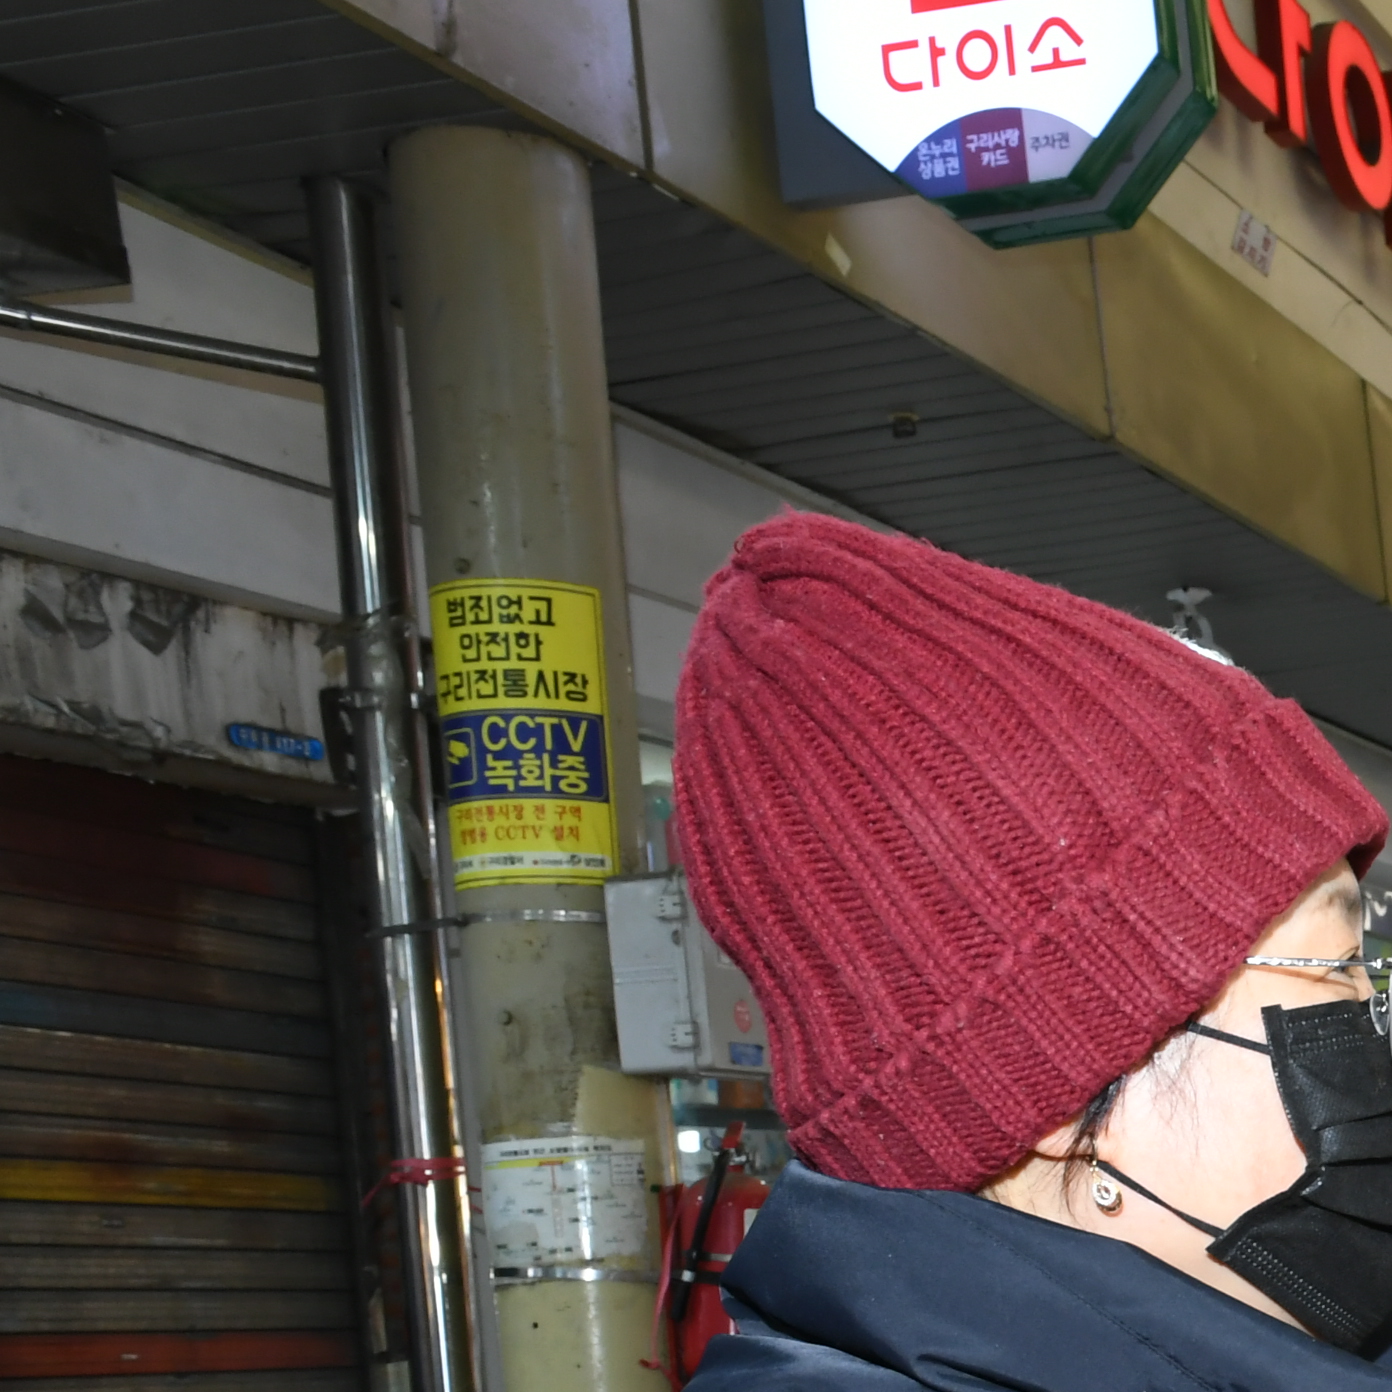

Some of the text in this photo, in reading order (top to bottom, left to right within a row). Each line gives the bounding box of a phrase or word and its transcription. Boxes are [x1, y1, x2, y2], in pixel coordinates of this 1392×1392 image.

[881, 17, 1086, 92] 다이소
[918, 139, 957, 154] 온누리
[965, 128, 1020, 150] 구리사랑
[919, 157, 960, 179] 상품권
[981, 150, 1010, 167] 카드
[446, 594, 556, 628] 범죄없고
[459, 631, 543, 663] 안전한
[440, 668, 589, 703] 구리전통시장
[481, 715, 588, 752] CCTV
[484, 752, 590, 794] 녹화중
[494, 824, 543, 841] CCTV
